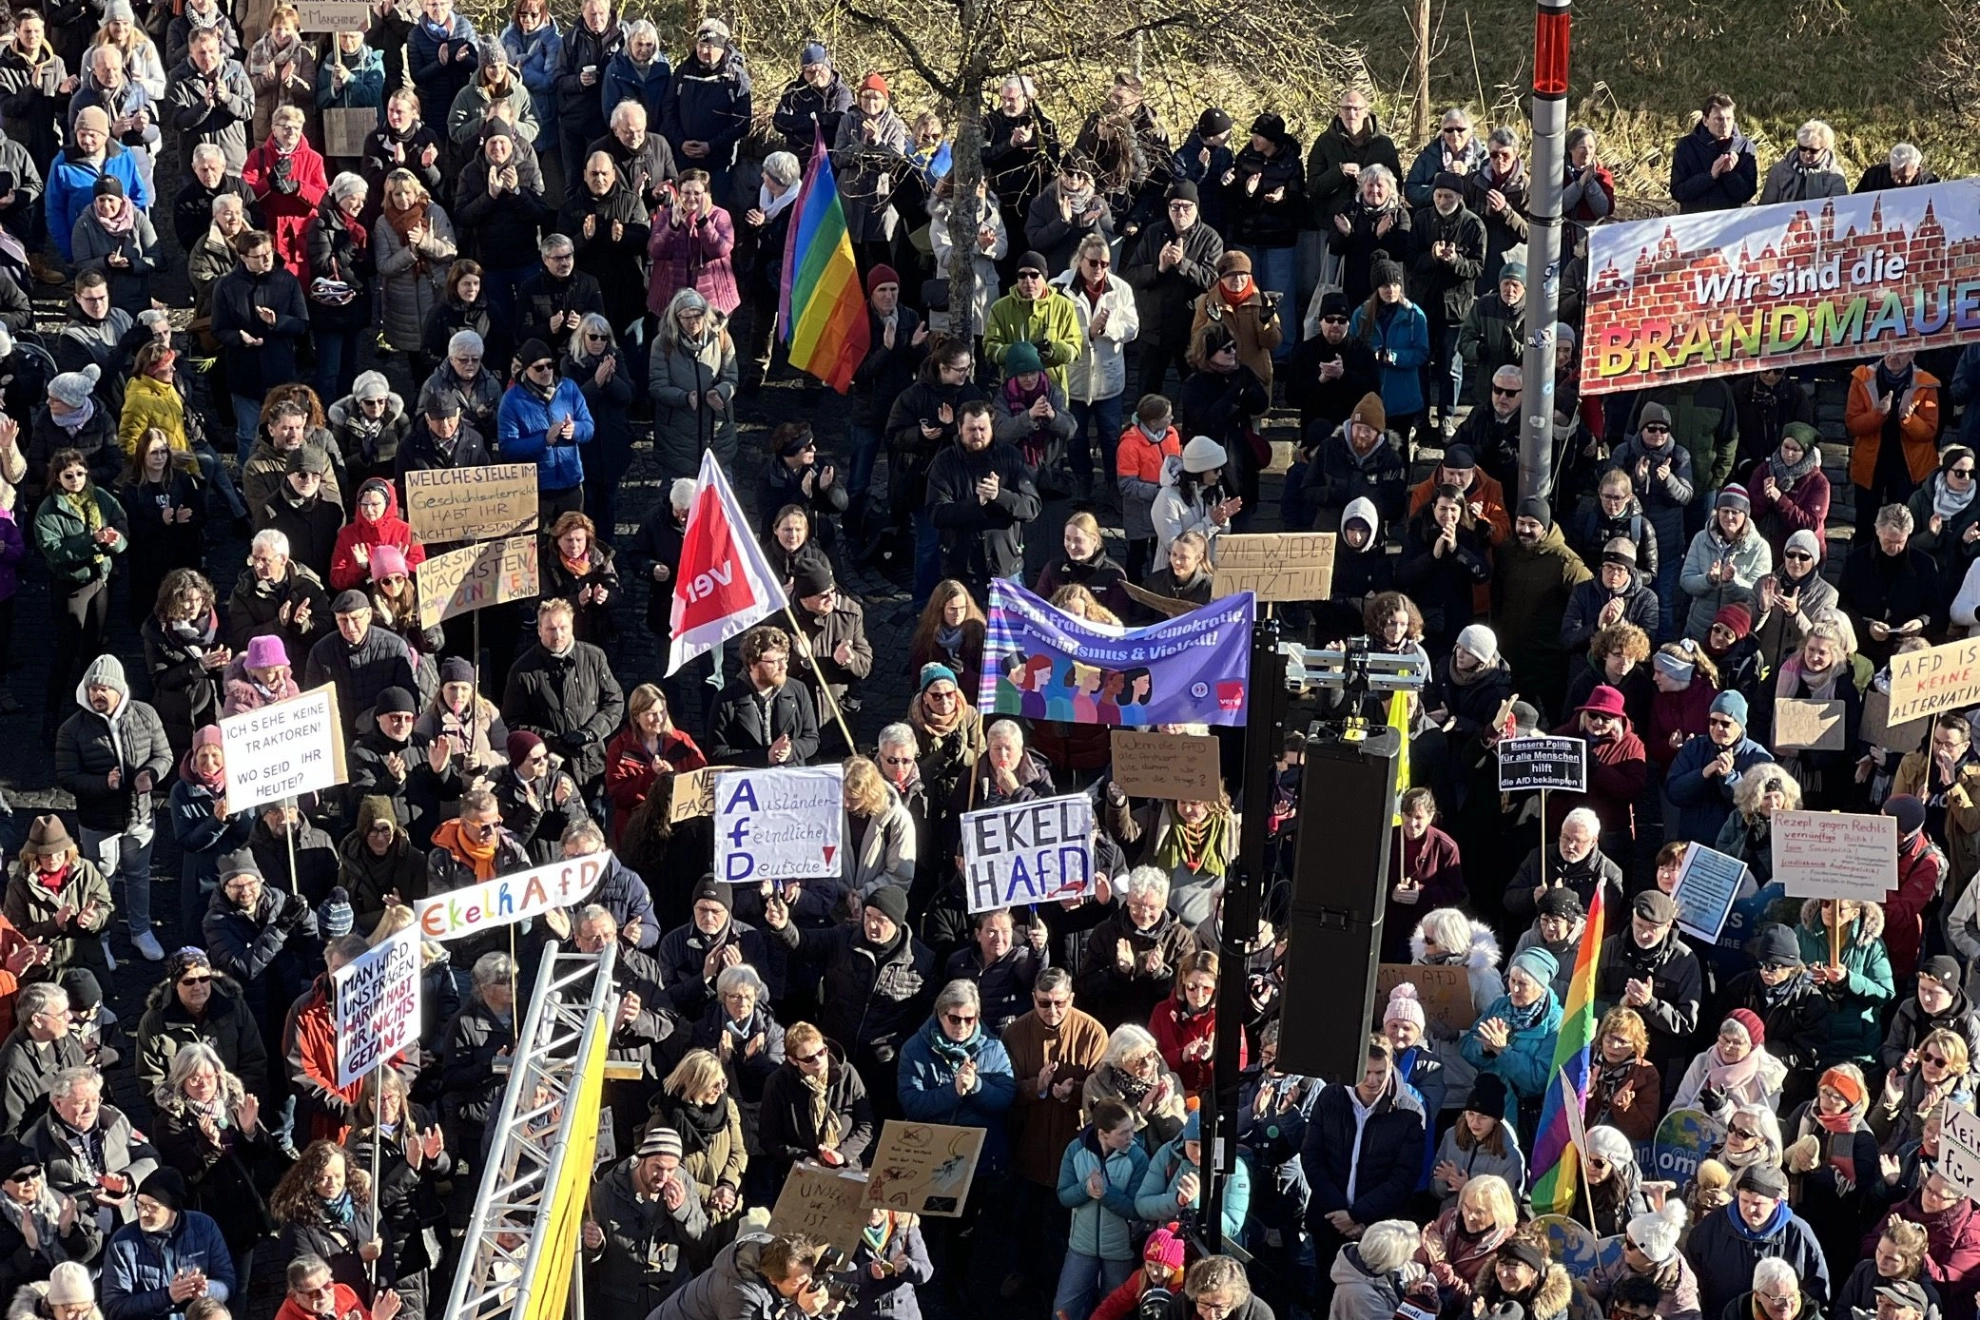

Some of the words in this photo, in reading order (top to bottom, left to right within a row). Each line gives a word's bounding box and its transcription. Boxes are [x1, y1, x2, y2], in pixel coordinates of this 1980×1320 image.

[1694, 268, 1762, 305] Wir
[1767, 253, 1841, 298] sind
[1850, 248, 1907, 283] die
[408, 467, 472, 487] WELCHE
[473, 465, 519, 483] STELLE
[521, 465, 537, 479] IM
[431, 507, 471, 522] HABT
[479, 502, 509, 517] IHR
[412, 526, 455, 542] NICHT
[1220, 539, 1258, 562] NIE
[1262, 536, 1332, 559] WIEDER
[418, 559, 449, 580] WER
[452, 545, 488, 565] SIND
[494, 538, 525, 551] DIE
[1262, 560, 1288, 573] IST
[1021, 623, 1128, 661] Feminismus
[1130, 647, 1146, 661] &
[1900, 653, 1943, 680] AFD
[1916, 667, 1973, 693] KEINE
[226, 723, 247, 740] ICH
[251, 711, 286, 732] SEHE
[292, 702, 325, 721] KEINE
[245, 721, 322, 754] TRAKTOREN!
[1117, 733, 1156, 750] Wenn
[1158, 740, 1176, 751] die
[1511, 741, 1545, 750] Bessere
[1546, 740, 1572, 750] Politik
[236, 768, 258, 785] WO
[263, 760, 291, 779] SEID
[301, 748, 322, 764] IHR
[1516, 752, 1532, 761] alle
[1533, 751, 1580, 762] Menschen
[1531, 763, 1553, 773] hilft
[723, 778, 839, 815] Ausländer-
[1501, 778, 1514, 787] die
[1515, 776, 1531, 786] AfD
[727, 816, 823, 848] feindliche
[975, 802, 1086, 857] EKEL
[1774, 812, 1812, 830] Rezept
[1818, 820, 1848, 832] gegen
[1851, 818, 1887, 834] Rechts
[341, 961, 374, 997] MAN
[376, 941, 409, 976] WIRD
[343, 986, 371, 1017] UNS
[371, 955, 414, 999] FRAGEN
[343, 996, 385, 1037] WARUM
[386, 974, 415, 1005] HABT
[344, 1028, 368, 1059] IHR
[371, 992, 416, 1040] NICHTS
[348, 1020, 406, 1074] GETAN?
[1944, 1148, 1975, 1188] für
[803, 1212, 828, 1228] IST
